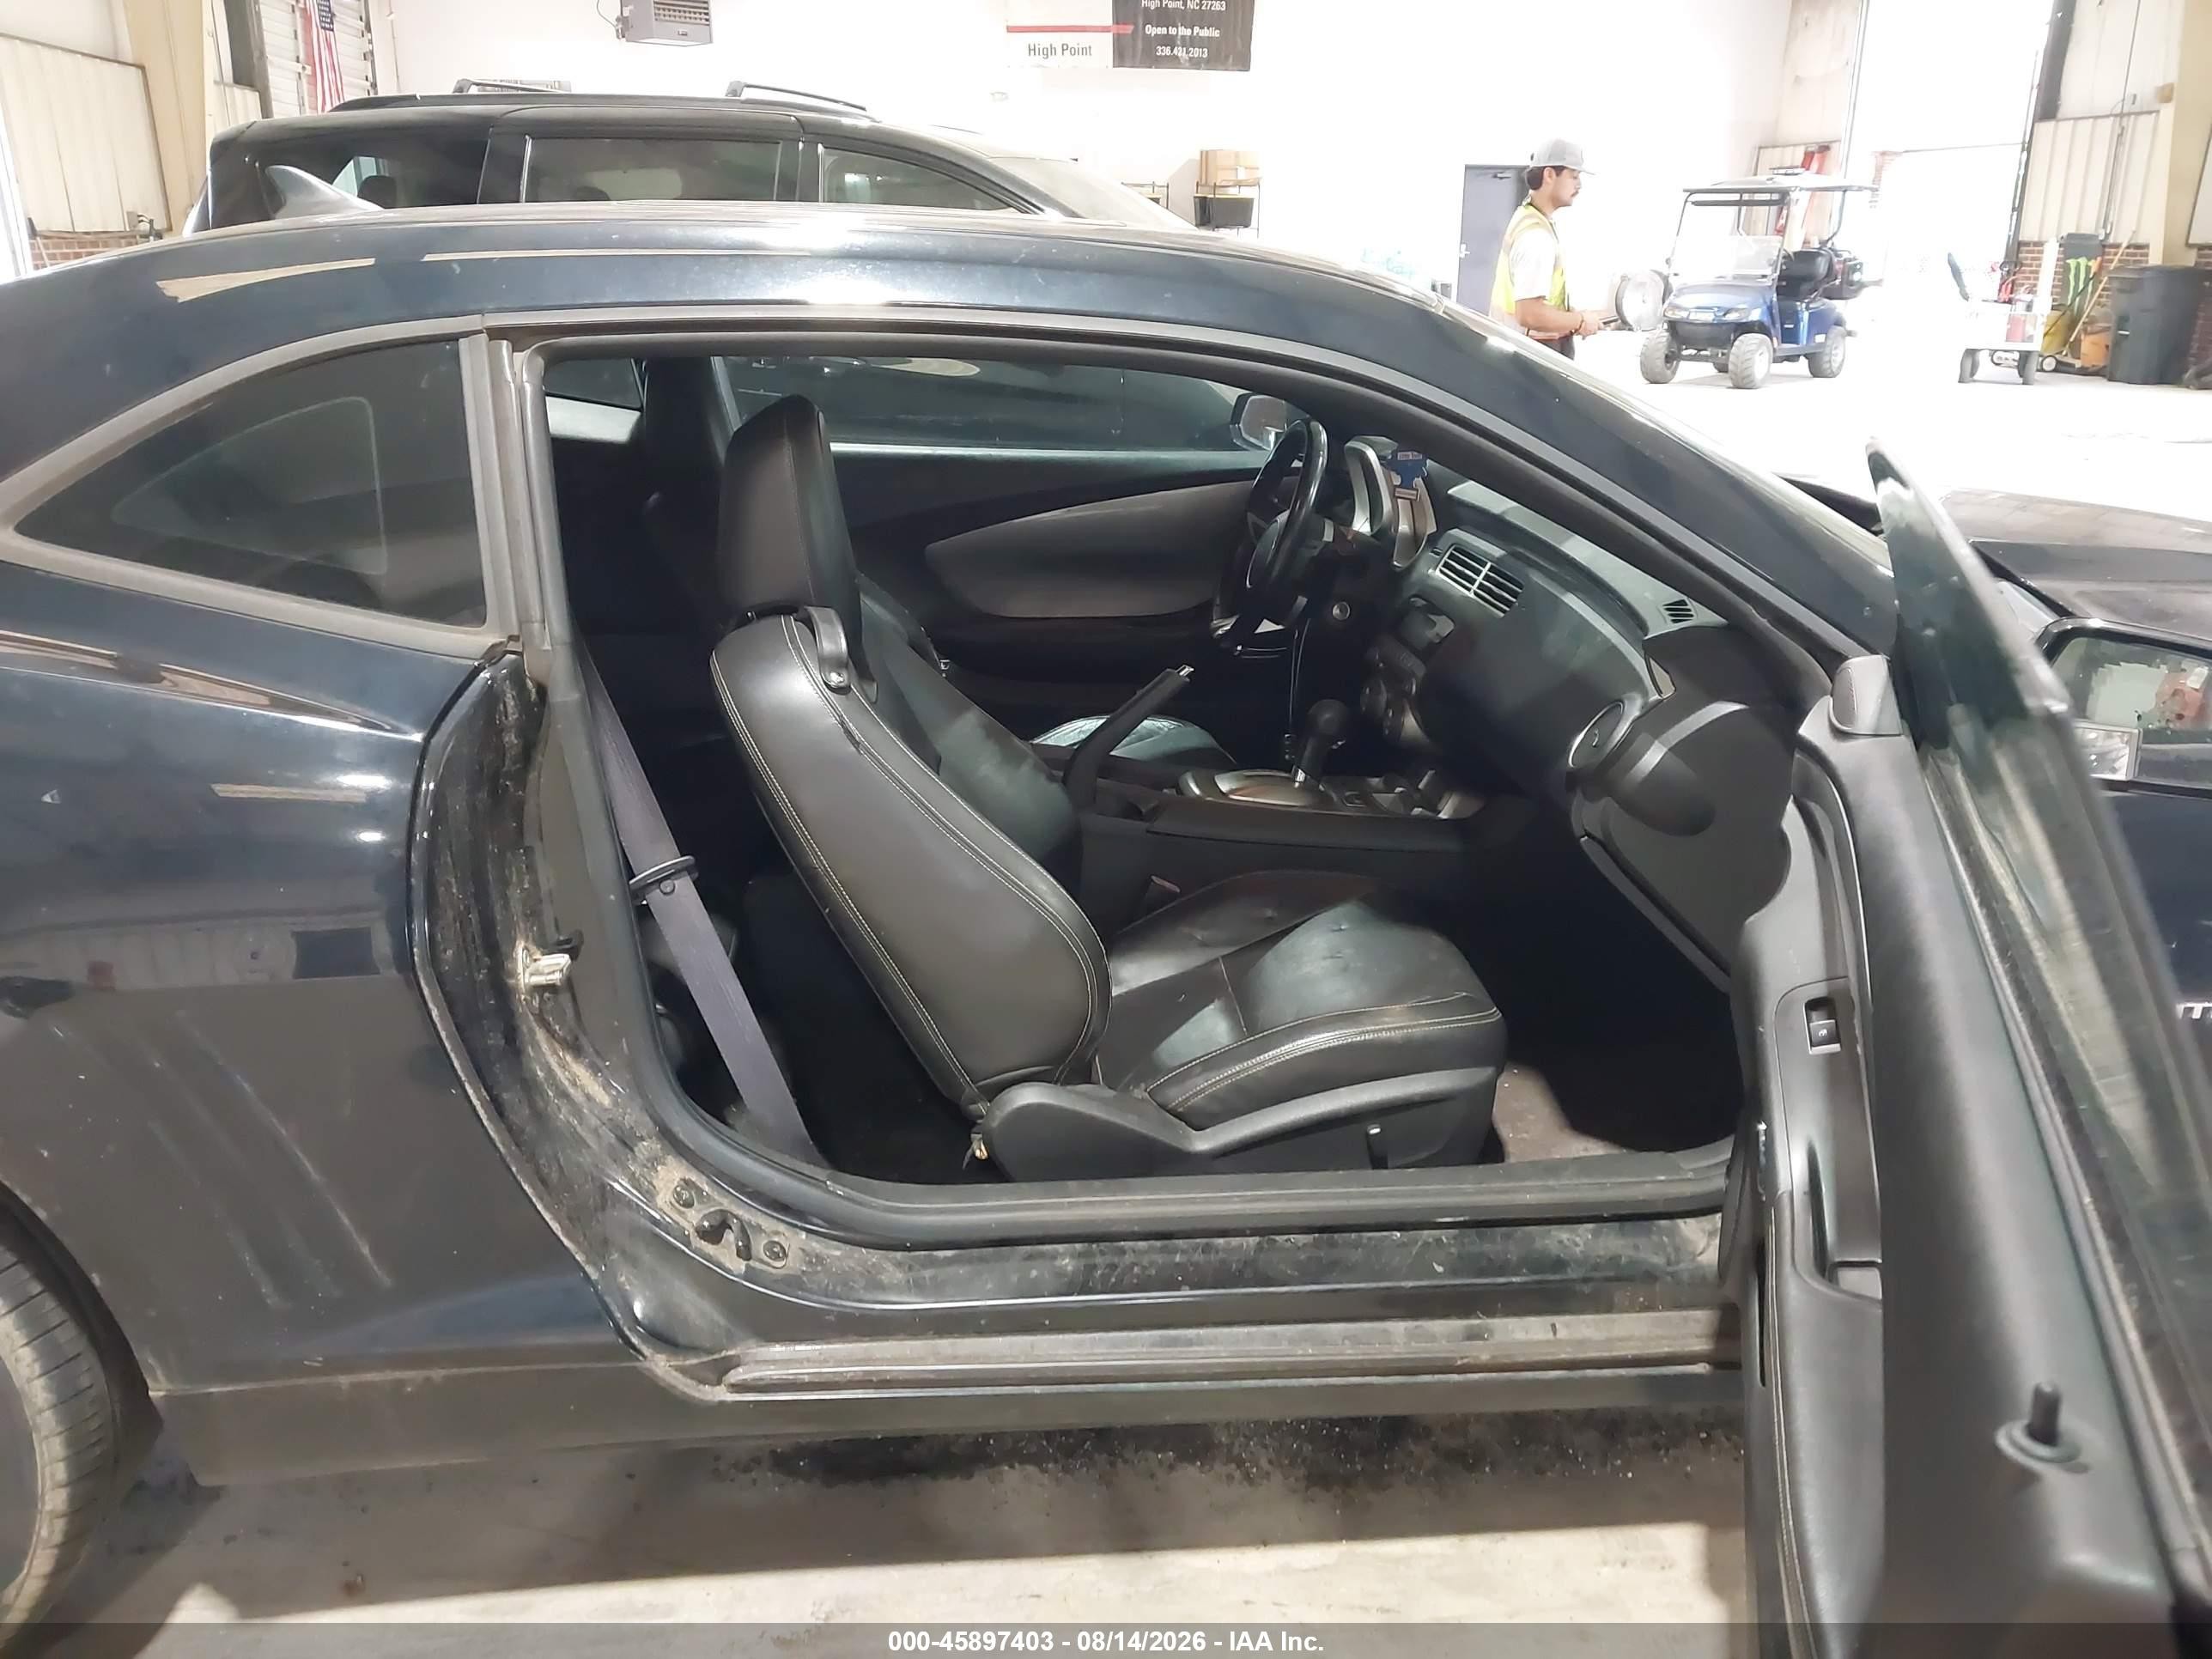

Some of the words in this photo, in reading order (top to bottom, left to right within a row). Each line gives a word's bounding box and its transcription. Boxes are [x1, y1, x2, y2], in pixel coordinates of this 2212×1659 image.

[1141, 0, 1160, 9] High
[1163, 0, 1185, 9] Point,
[1187, 1, 1200, 9] NC
[1201, 1, 1226, 11] 27263
[1145, 25, 1168, 36] Open
[1168, 27, 1177, 35] to
[1178, 25, 1192, 36] the
[1193, 27, 1220, 37] Public
[1028, 43, 1057, 58] High
[1061, 43, 1092, 57] Point
[1156, 46, 1208, 58] 336.421.2013
